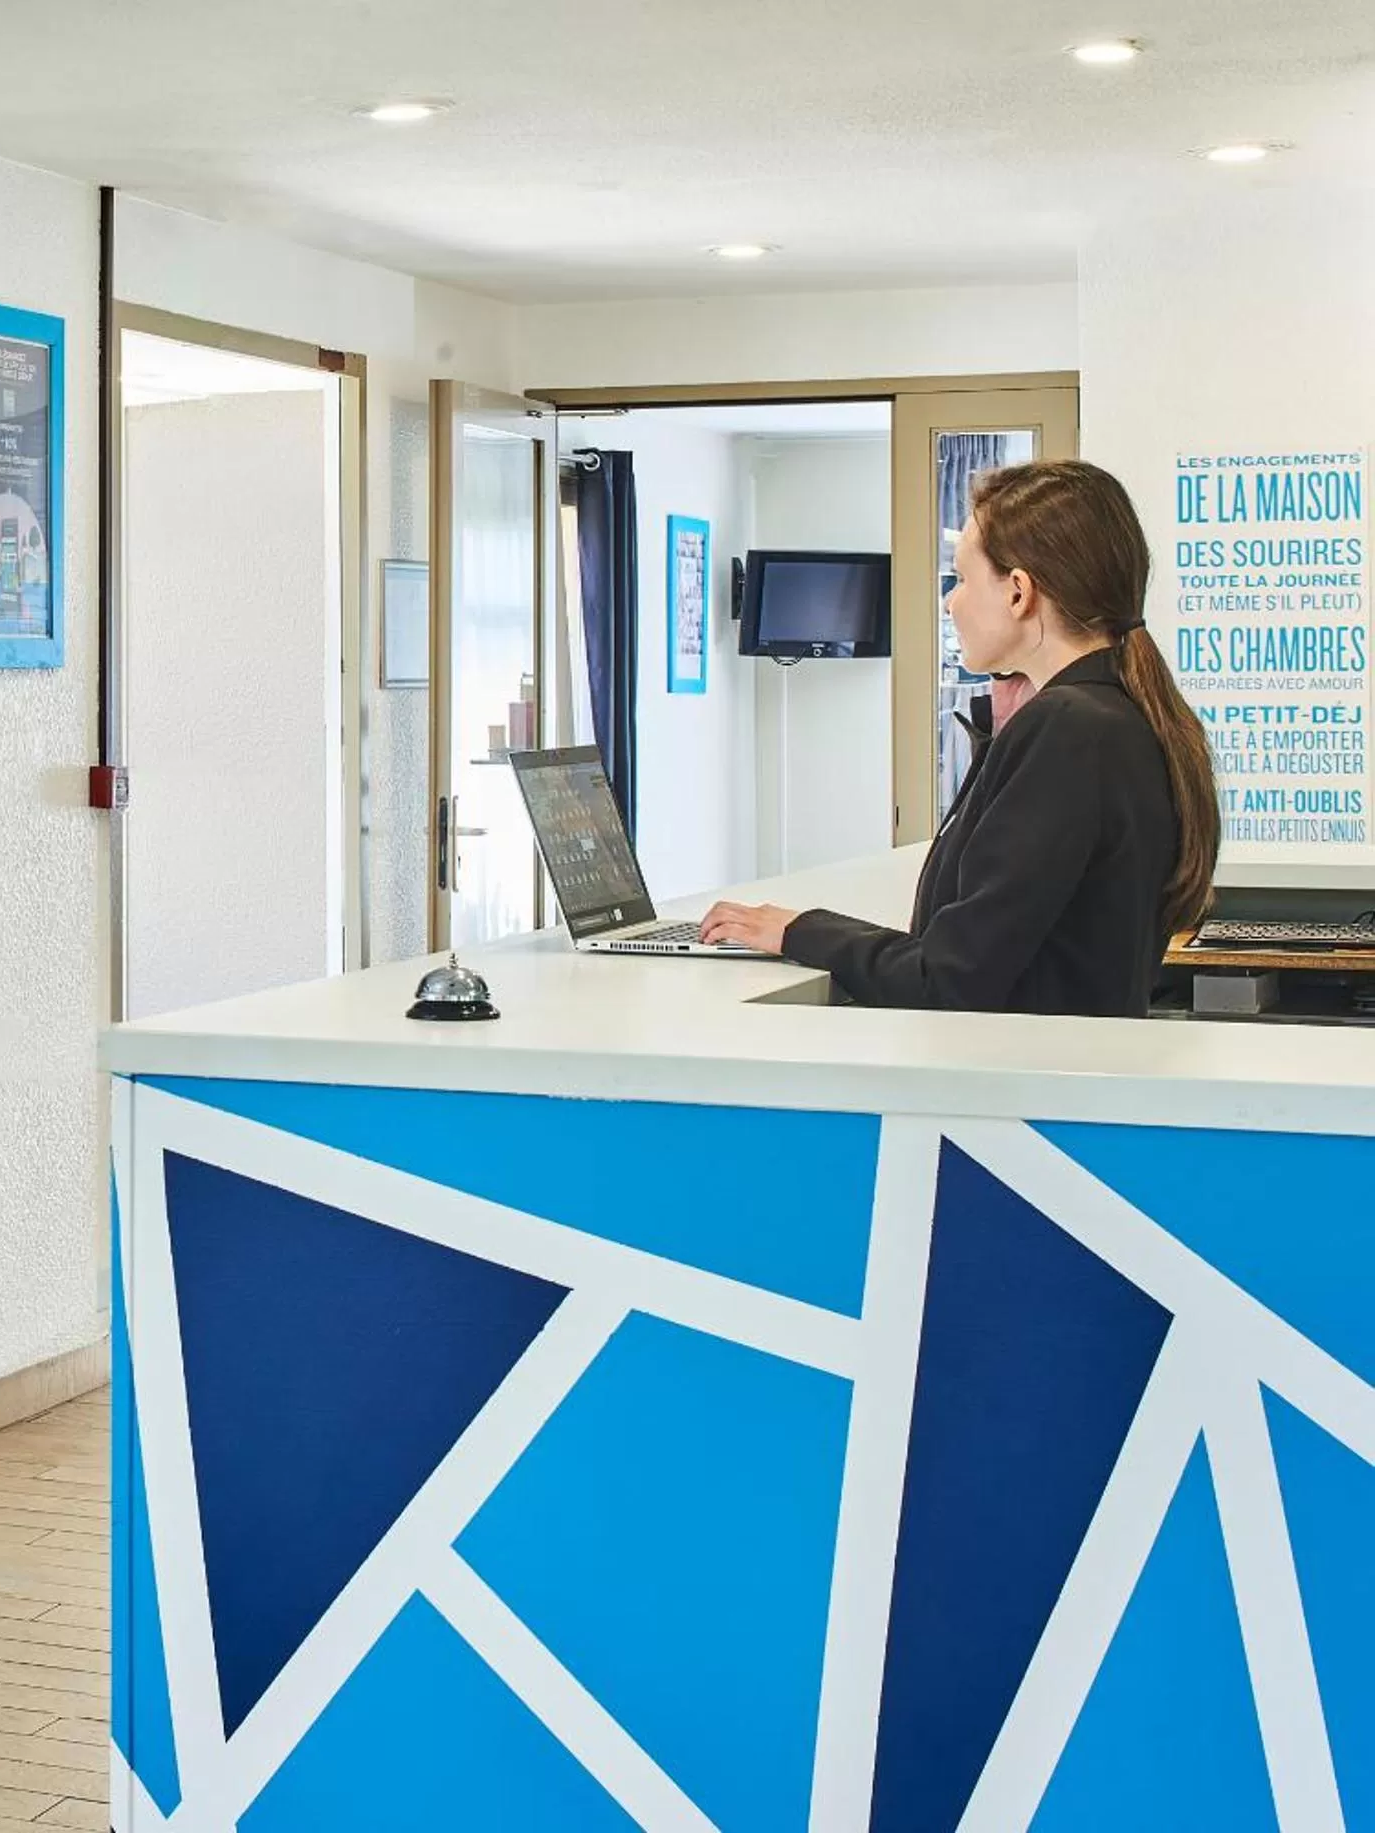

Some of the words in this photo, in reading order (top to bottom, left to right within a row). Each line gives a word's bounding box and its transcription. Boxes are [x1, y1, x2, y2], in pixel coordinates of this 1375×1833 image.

[1176, 457, 1211, 468] LES
[1217, 454, 1361, 467] ENGAGEMENTS
[1177, 474, 1209, 523] DE
[1217, 473, 1247, 523] LA
[1256, 470, 1362, 521] MAISON
[1176, 540, 1224, 568] DES
[1233, 538, 1362, 567] SOURIRES
[1179, 574, 1239, 588] TOUTE
[1245, 574, 1268, 588] LA
[1274, 571, 1361, 587] JOURNÉE
[1177, 595, 1204, 614] (ET
[1209, 592, 1260, 611] MÊME
[1265, 595, 1295, 611] S'IL
[1301, 593, 1362, 612] PLEUT)
[1177, 627, 1222, 672] DES
[1230, 627, 1365, 672] CHAMBRES
[1266, 678, 1305, 690] AVEC
[1309, 678, 1363, 690] AMOUR
[1199, 705, 1217, 724] N
[1225, 700, 1362, 724] PETIT-DÉJ
[1263, 731, 1363, 750] EMPORTER
[1244, 789, 1362, 813] ANTI-OUBLIS
[1256, 819, 1275, 841] LES
[1279, 819, 1318, 841] PETITS
[1321, 819, 1365, 841] ENNUIS
